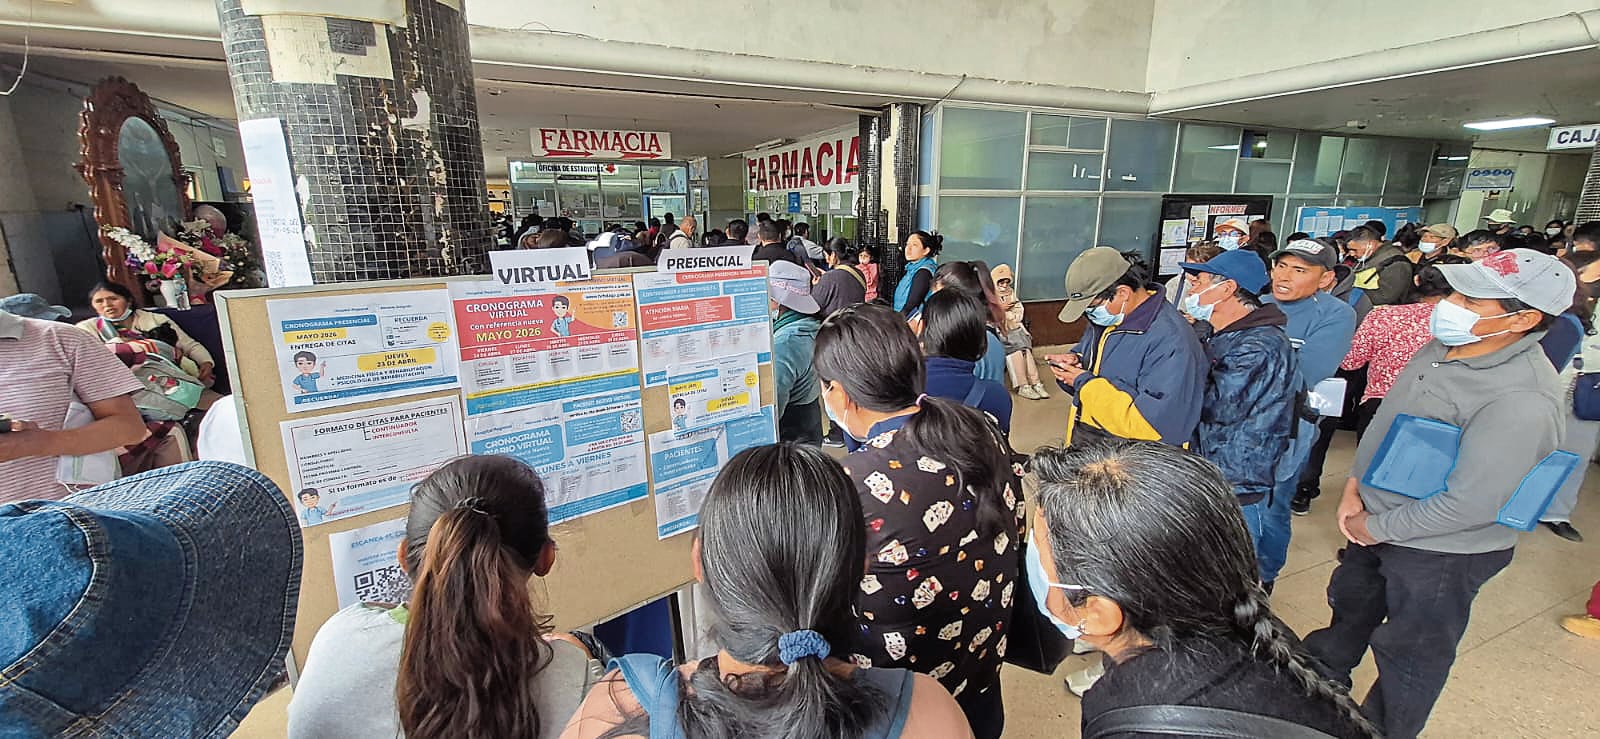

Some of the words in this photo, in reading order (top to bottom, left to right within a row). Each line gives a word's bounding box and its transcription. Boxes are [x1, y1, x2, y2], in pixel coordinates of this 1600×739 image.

[540, 129, 663, 152] FARMACIA
[747, 136, 860, 192] FARMACIA
[812, 200, 818, 216] 3
[667, 255, 744, 270] PRESENCIAL
[498, 263, 588, 285] VIRTUAL
[466, 299, 544, 313] CRONOGRAMA
[489, 310, 528, 319] VIRTUAL
[470, 323, 485, 331] Con
[485, 320, 522, 330] referencia
[522, 318, 544, 326] nueva
[476, 330, 512, 343] MAYO
[516, 327, 541, 338] 2026
[290, 342, 324, 351] ENTREGA
[336, 339, 357, 347] CITAS
[384, 352, 409, 361] JUEVES
[314, 422, 354, 435] FORMATO
[368, 417, 389, 427] CITAS
[390, 413, 410, 423] PARA
[410, 407, 448, 419] PACIENTES
[371, 421, 417, 433] CONTINUADOR
[372, 428, 419, 440] INTERCONSULTA
[485, 429, 551, 449] CRONOGRAMA
[518, 437, 553, 450] VIRTUAL
[568, 459, 576, 468] A
[576, 451, 612, 465] VIERNES
[664, 446, 704, 460] PACIENTES
[337, 484, 346, 493] tu
[346, 479, 378, 493] formato
